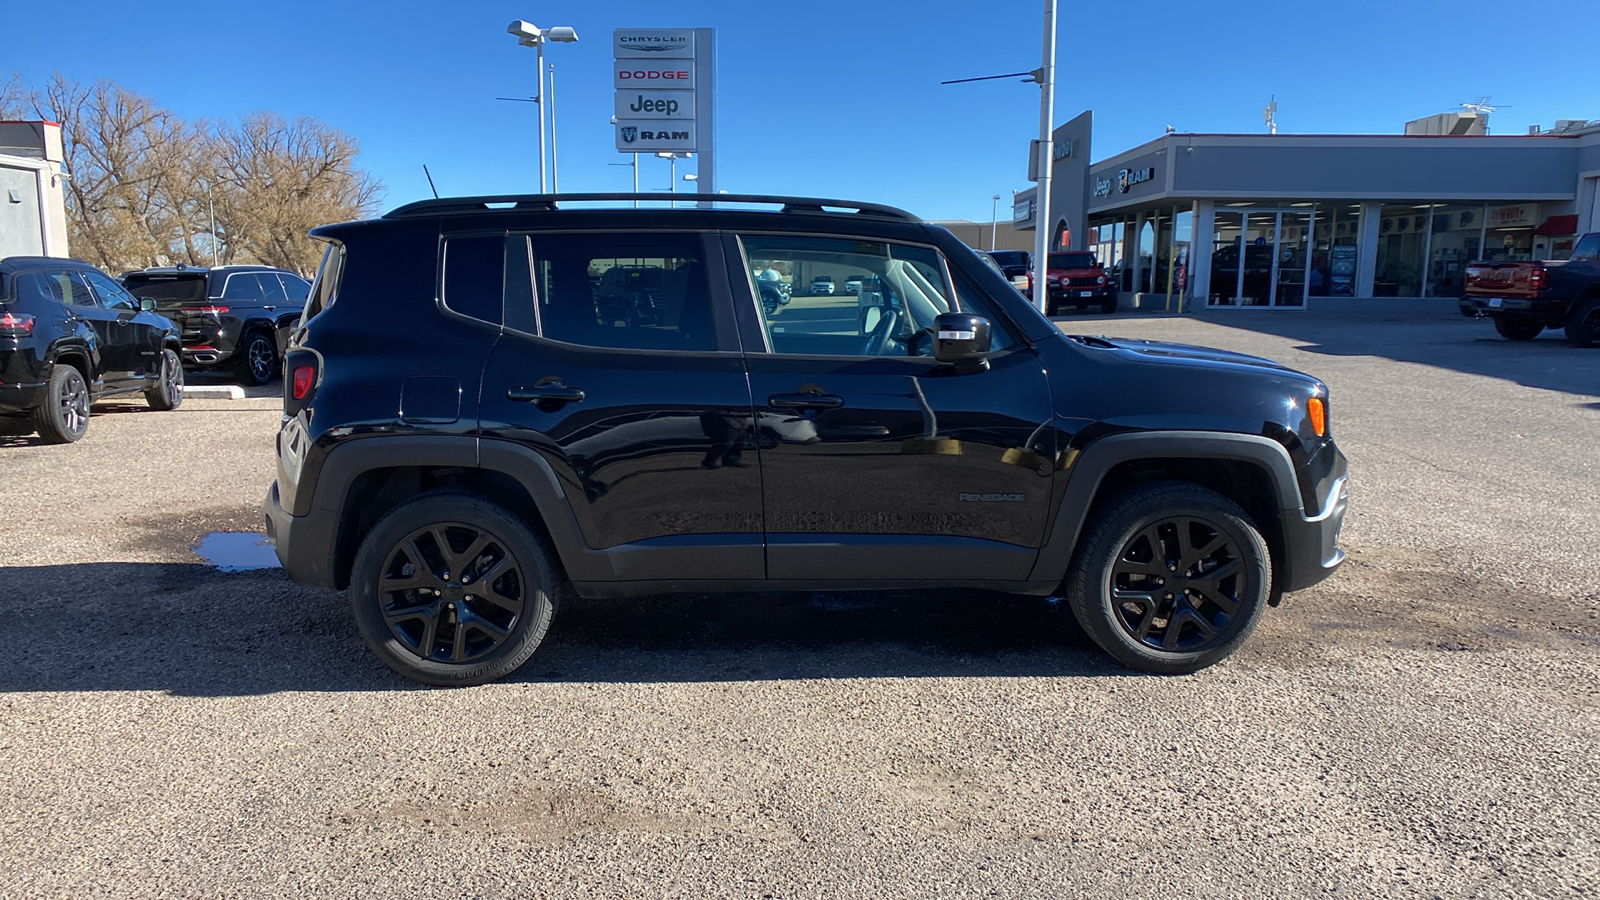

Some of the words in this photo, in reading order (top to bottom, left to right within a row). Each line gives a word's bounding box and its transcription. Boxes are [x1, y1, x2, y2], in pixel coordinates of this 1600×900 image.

[619, 71, 688, 79] DODGE
[630, 95, 679, 115] Jeep
[640, 131, 689, 140] RAM
[1093, 176, 1111, 198] Jeep
[1128, 167, 1150, 185] RAM
[959, 492, 1026, 502] RENEGADE
